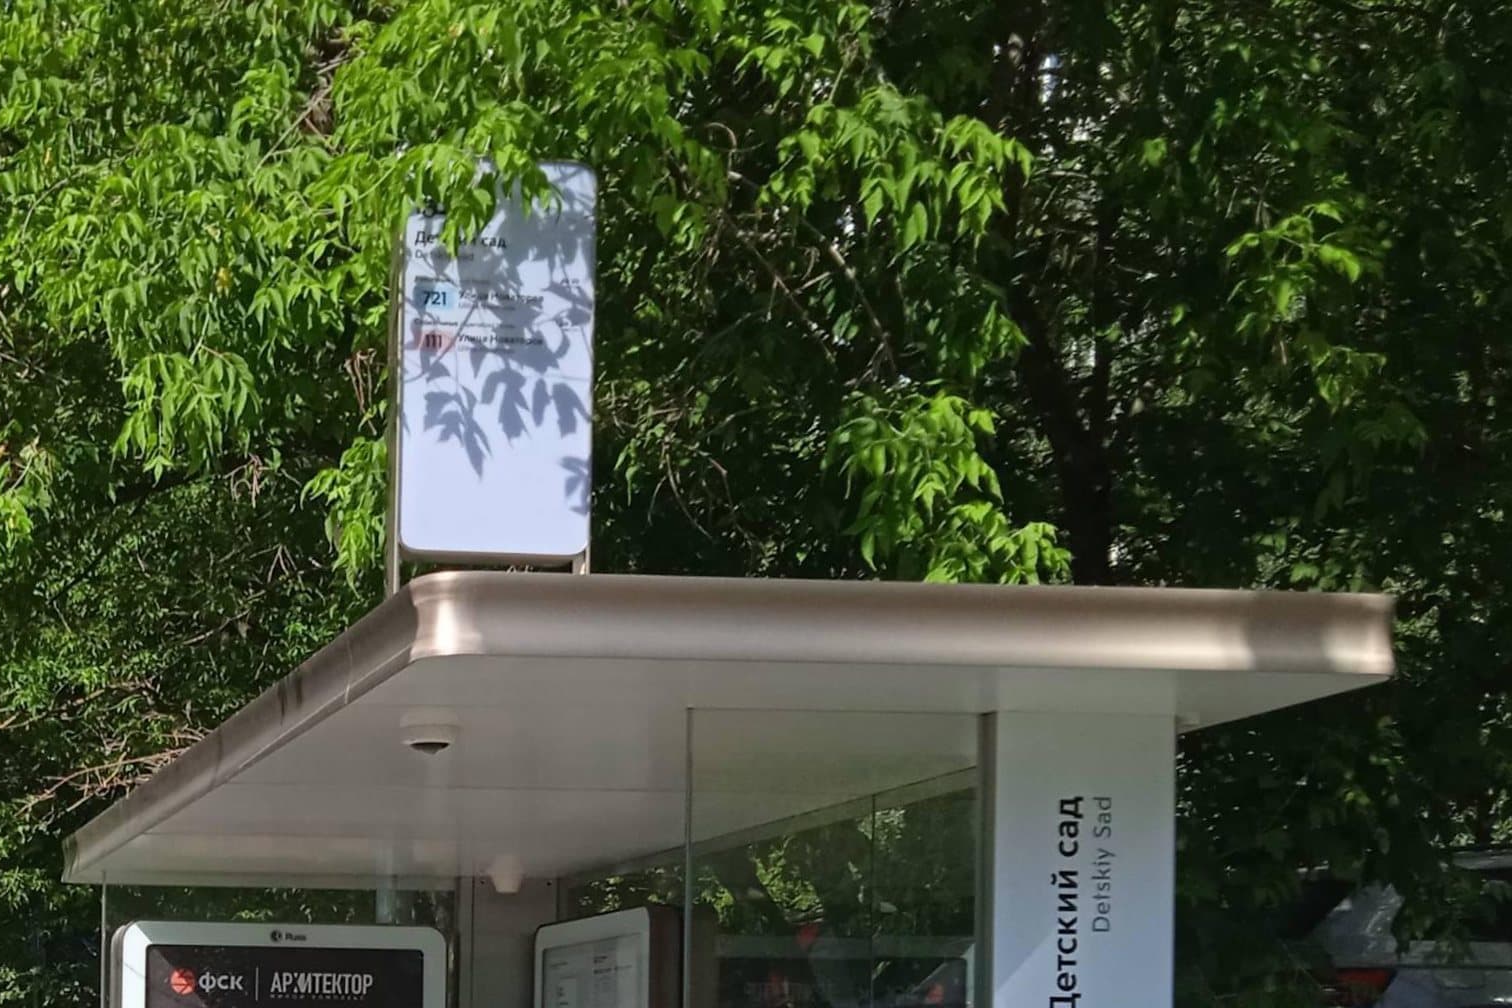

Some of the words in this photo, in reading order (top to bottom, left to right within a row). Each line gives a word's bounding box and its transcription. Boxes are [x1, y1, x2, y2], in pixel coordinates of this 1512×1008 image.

[423, 291, 447, 305] 721
[1058, 796, 1084, 857] сад
[1093, 796, 1112, 839] Sad
[1092, 848, 1116, 933] Detskiy
[270, 972, 373, 995] АРХИТЕКТОР
